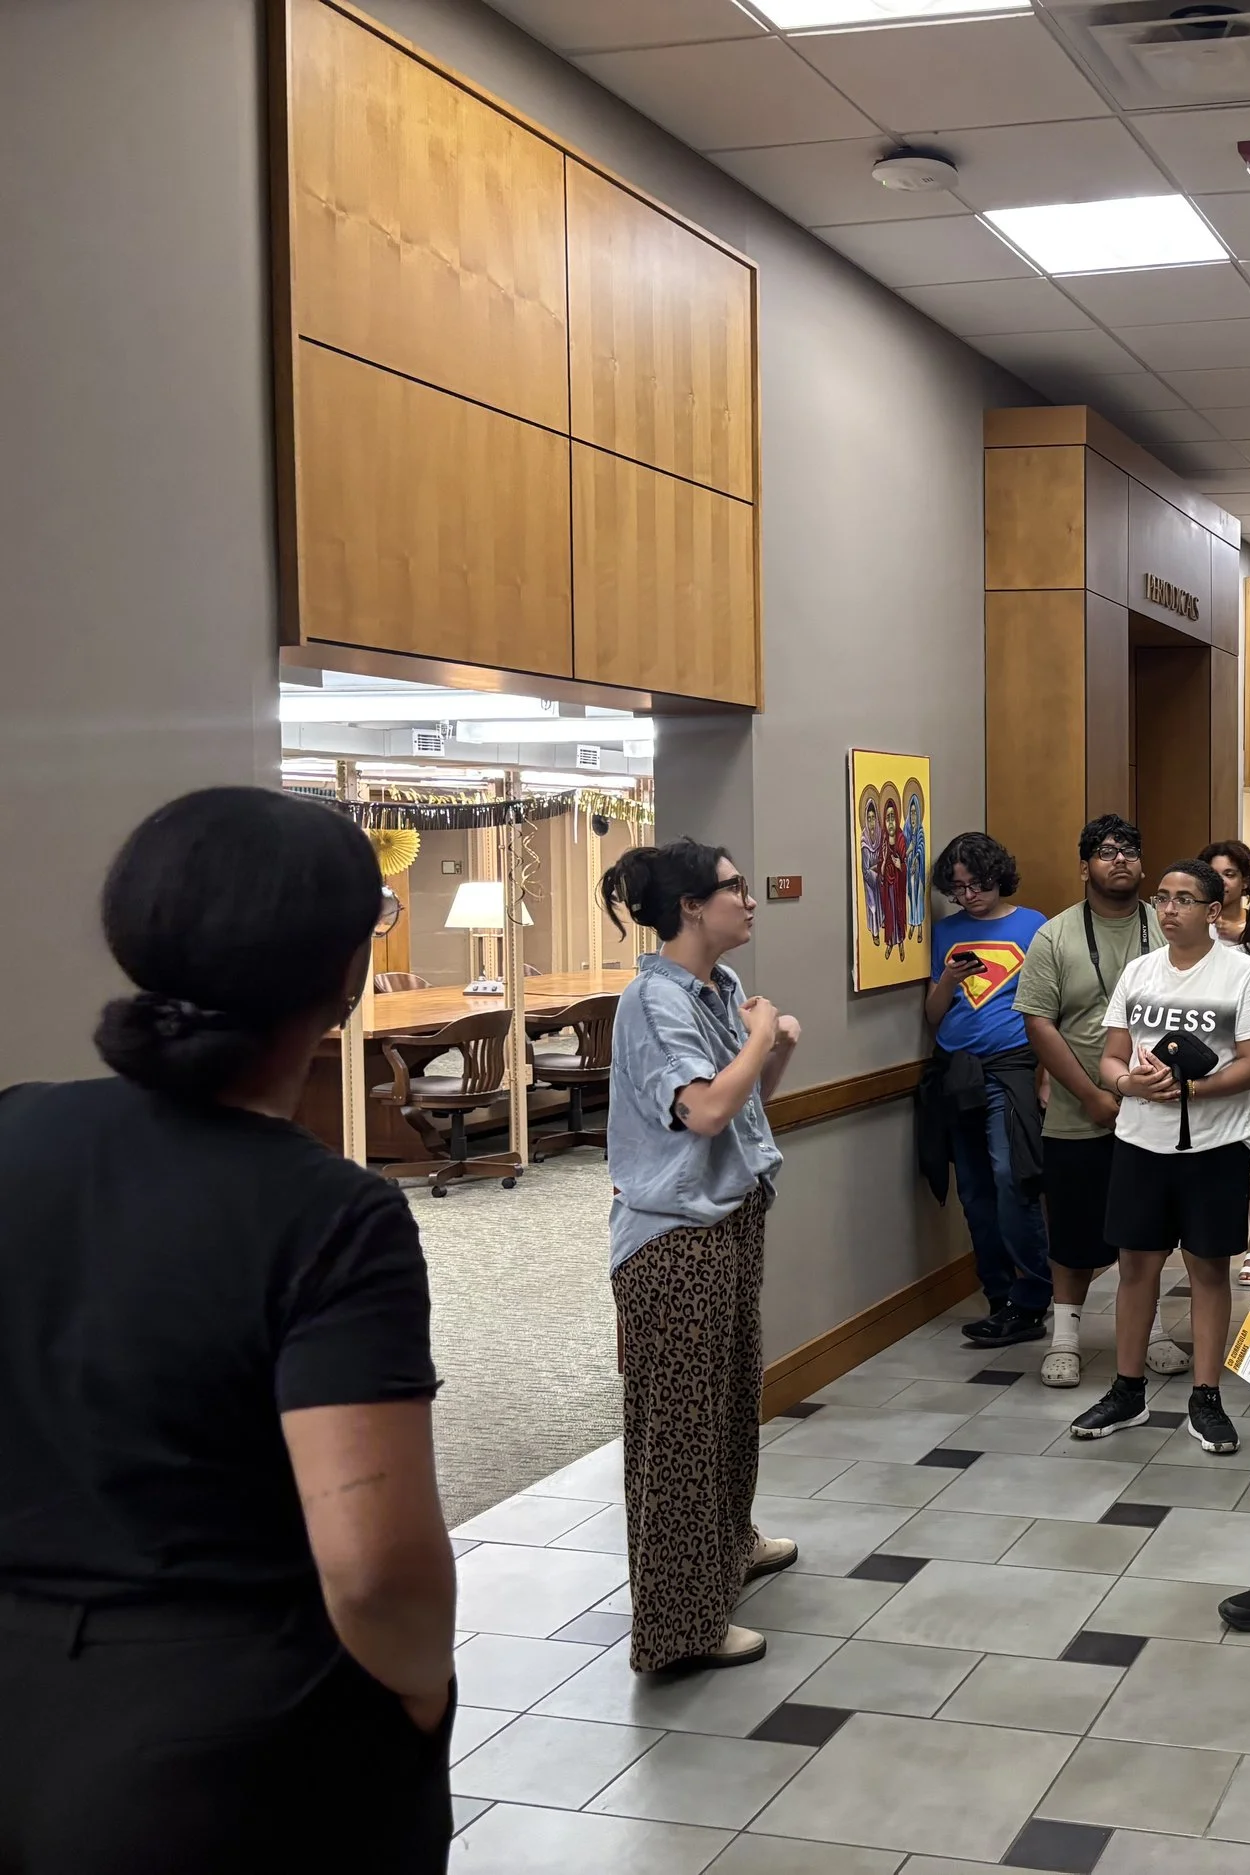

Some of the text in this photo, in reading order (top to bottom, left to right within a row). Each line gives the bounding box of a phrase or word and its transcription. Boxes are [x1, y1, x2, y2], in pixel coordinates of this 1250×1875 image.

[778, 878, 790, 889] 212
[1130, 1004, 1216, 1032] GUESS
[1233, 1345, 1249, 1371] PROGRAMS
